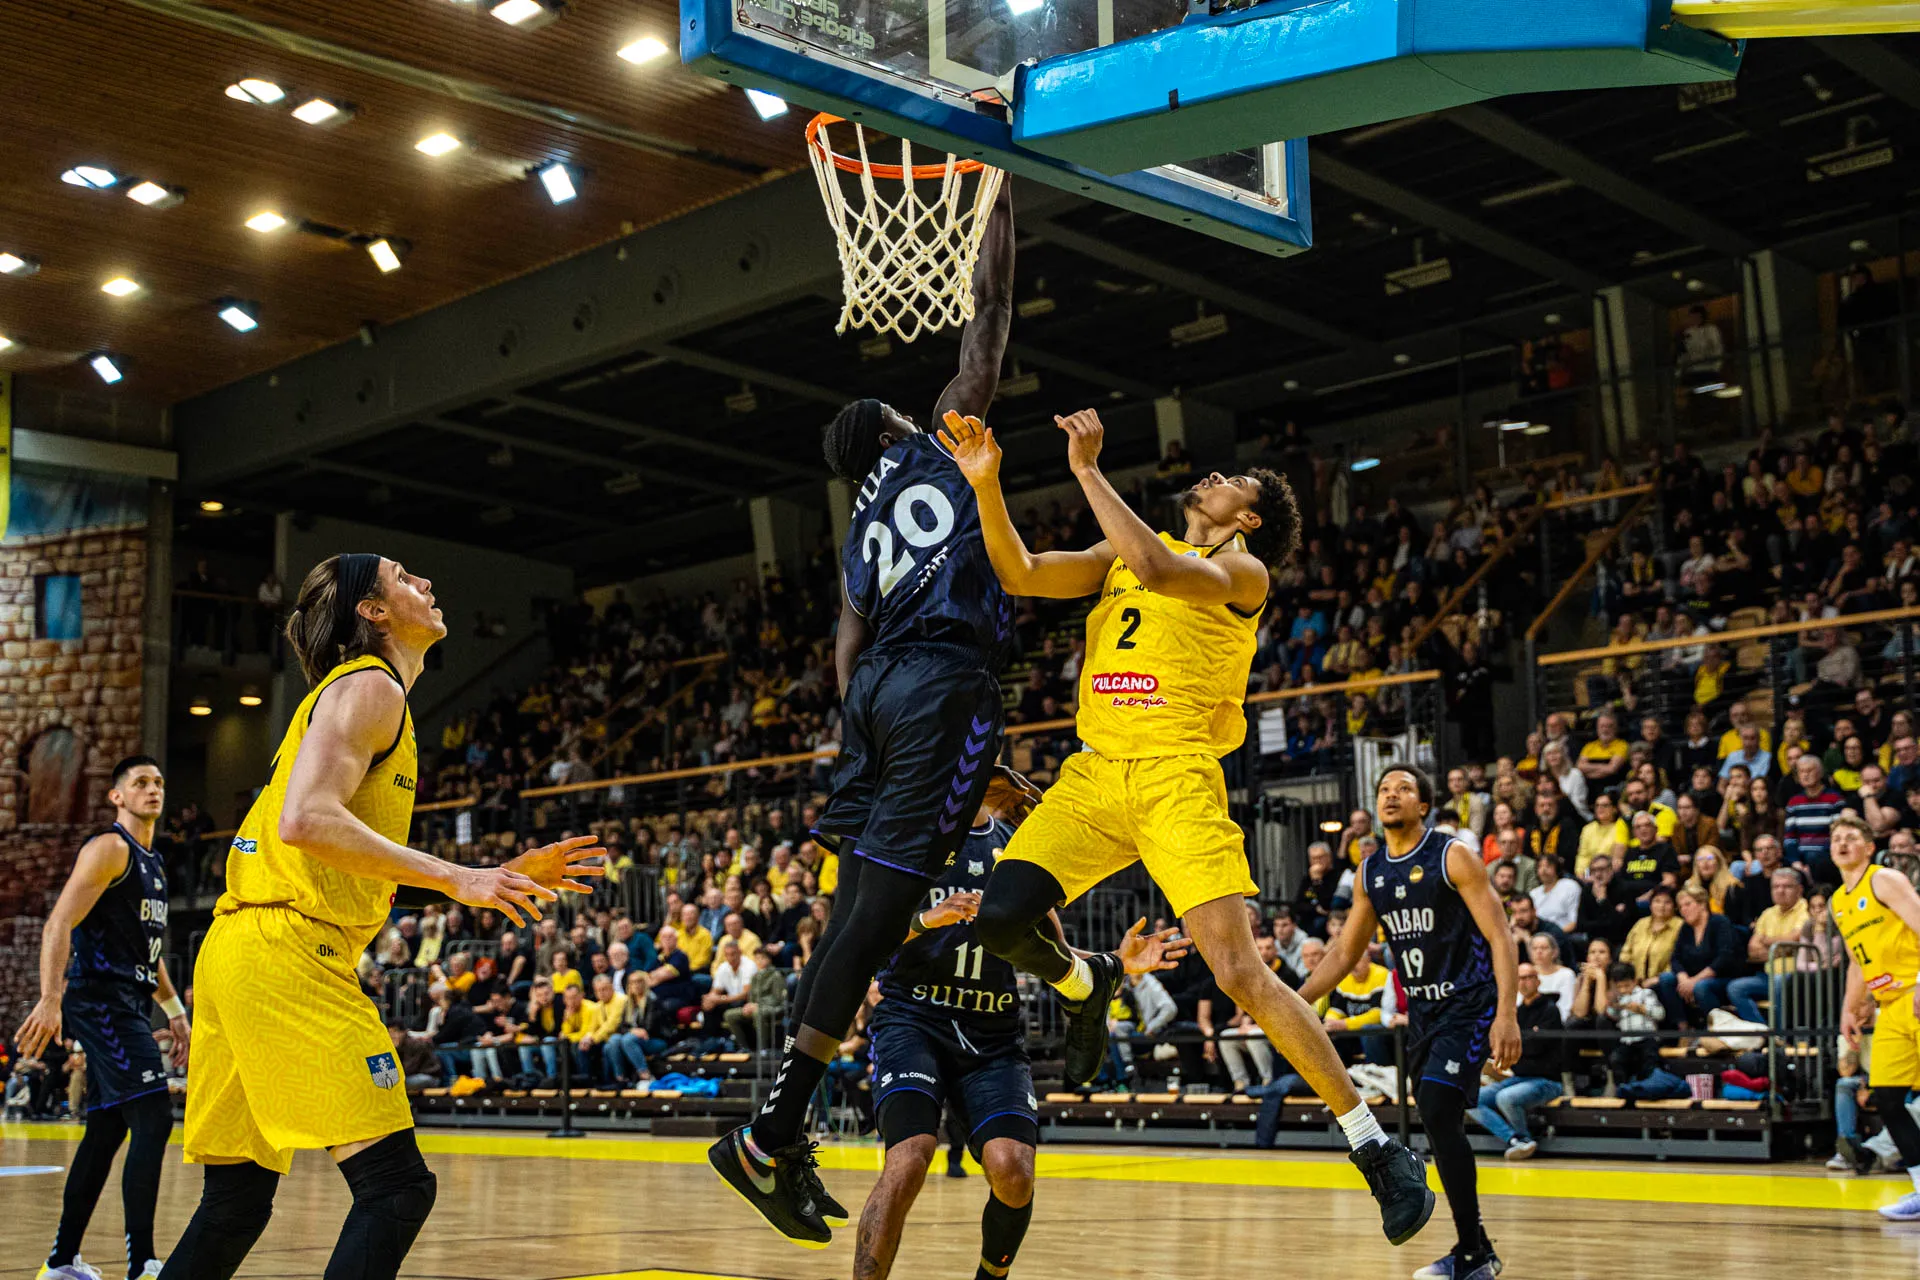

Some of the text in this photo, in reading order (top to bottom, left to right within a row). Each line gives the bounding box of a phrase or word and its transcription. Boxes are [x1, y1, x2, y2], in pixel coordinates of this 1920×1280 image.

[862, 483, 955, 599] 20
[1116, 607, 1142, 650] 2
[1092, 676, 1156, 691] VULCANO
[954, 941, 984, 980] 11
[1401, 947, 1424, 979] 19
[911, 984, 1014, 1014] surne
[1402, 981, 1455, 1001] urne
